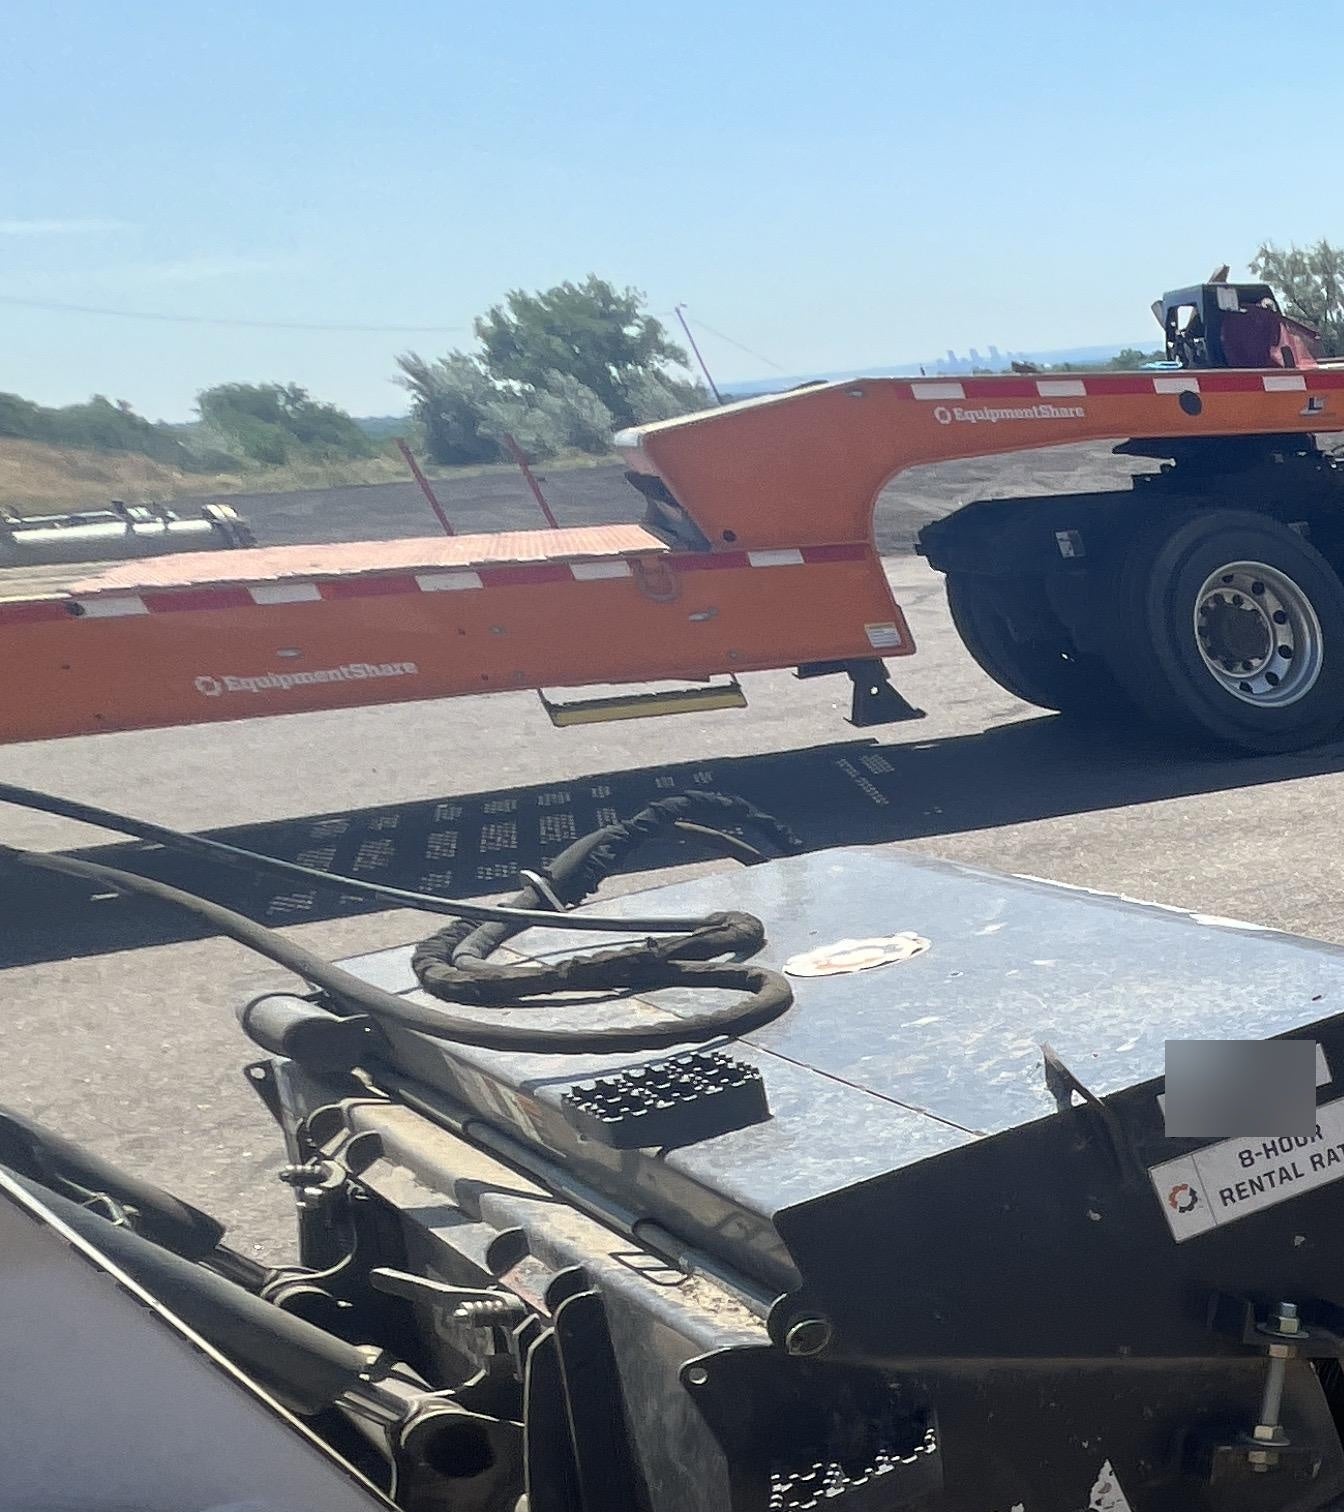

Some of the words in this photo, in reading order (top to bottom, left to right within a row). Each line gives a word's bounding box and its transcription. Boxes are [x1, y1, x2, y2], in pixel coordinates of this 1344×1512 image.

[953, 404, 1085, 423] EquipmentShare
[222, 661, 419, 692] EquipmentShare
[1219, 1161, 1305, 1207] RENTAL
